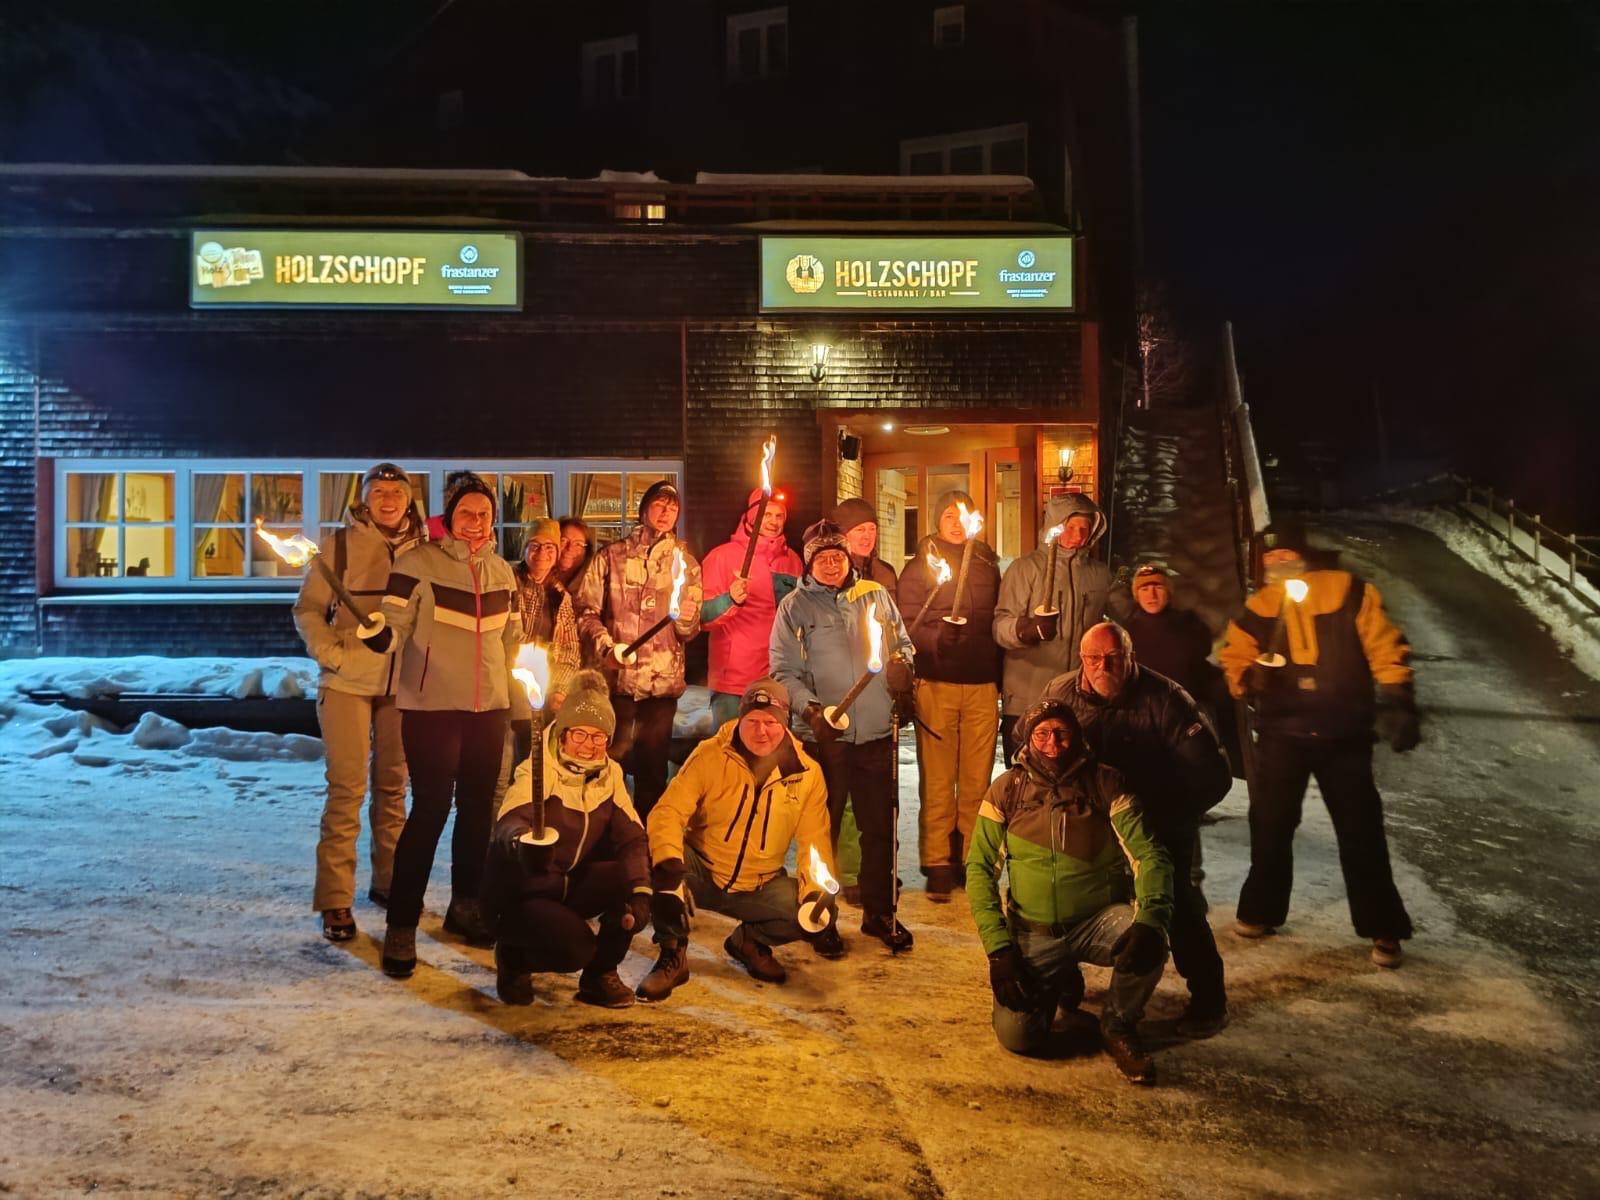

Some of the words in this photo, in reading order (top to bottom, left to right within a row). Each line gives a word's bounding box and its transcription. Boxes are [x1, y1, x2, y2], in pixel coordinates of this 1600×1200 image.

[275, 254, 427, 285] HOLZSCHOPF
[441, 264, 500, 278] frastanzer
[835, 260, 979, 288] HOLZSCHOPF
[999, 269, 1056, 282] frastanzer
[867, 289, 919, 298] RESTAURANT
[930, 289, 946, 298] BAR
